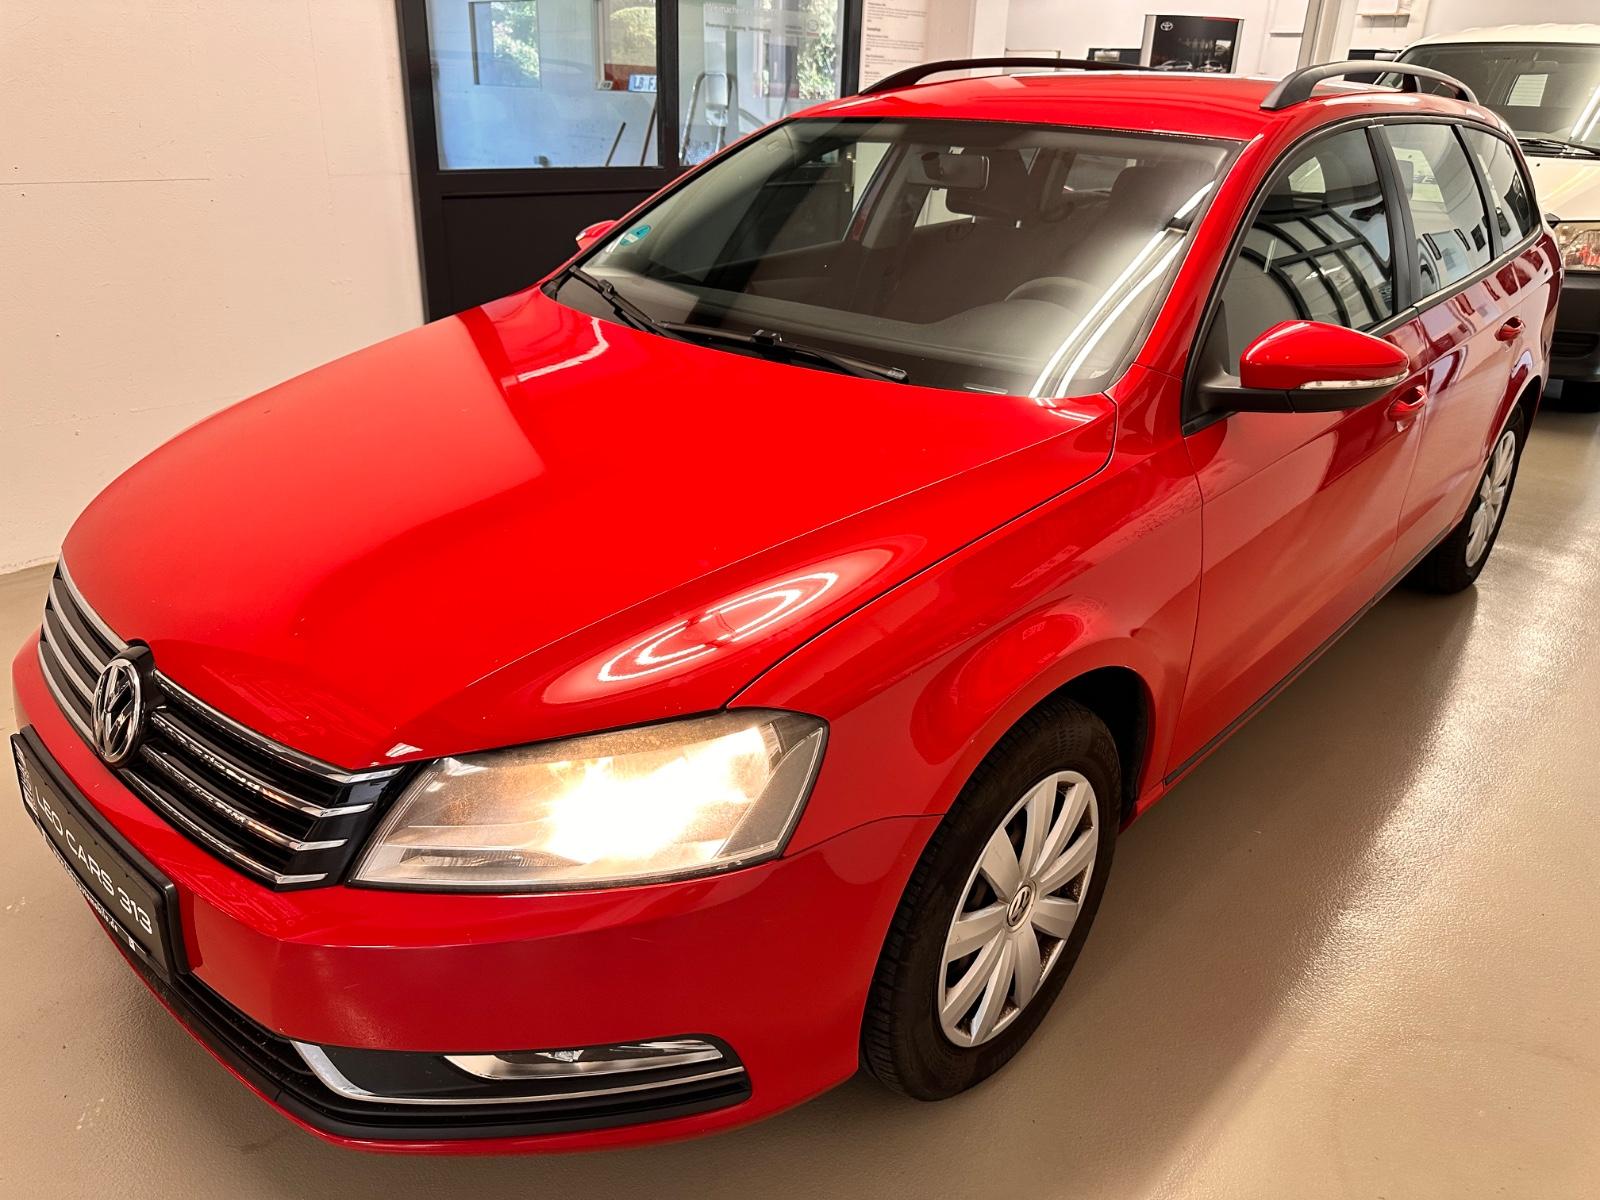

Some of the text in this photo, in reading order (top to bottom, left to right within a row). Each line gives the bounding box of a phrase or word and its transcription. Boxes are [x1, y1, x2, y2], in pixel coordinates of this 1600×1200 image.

[35, 785, 63, 836] LEO
[65, 829, 114, 896] CARS
[117, 886, 153, 935] 313
